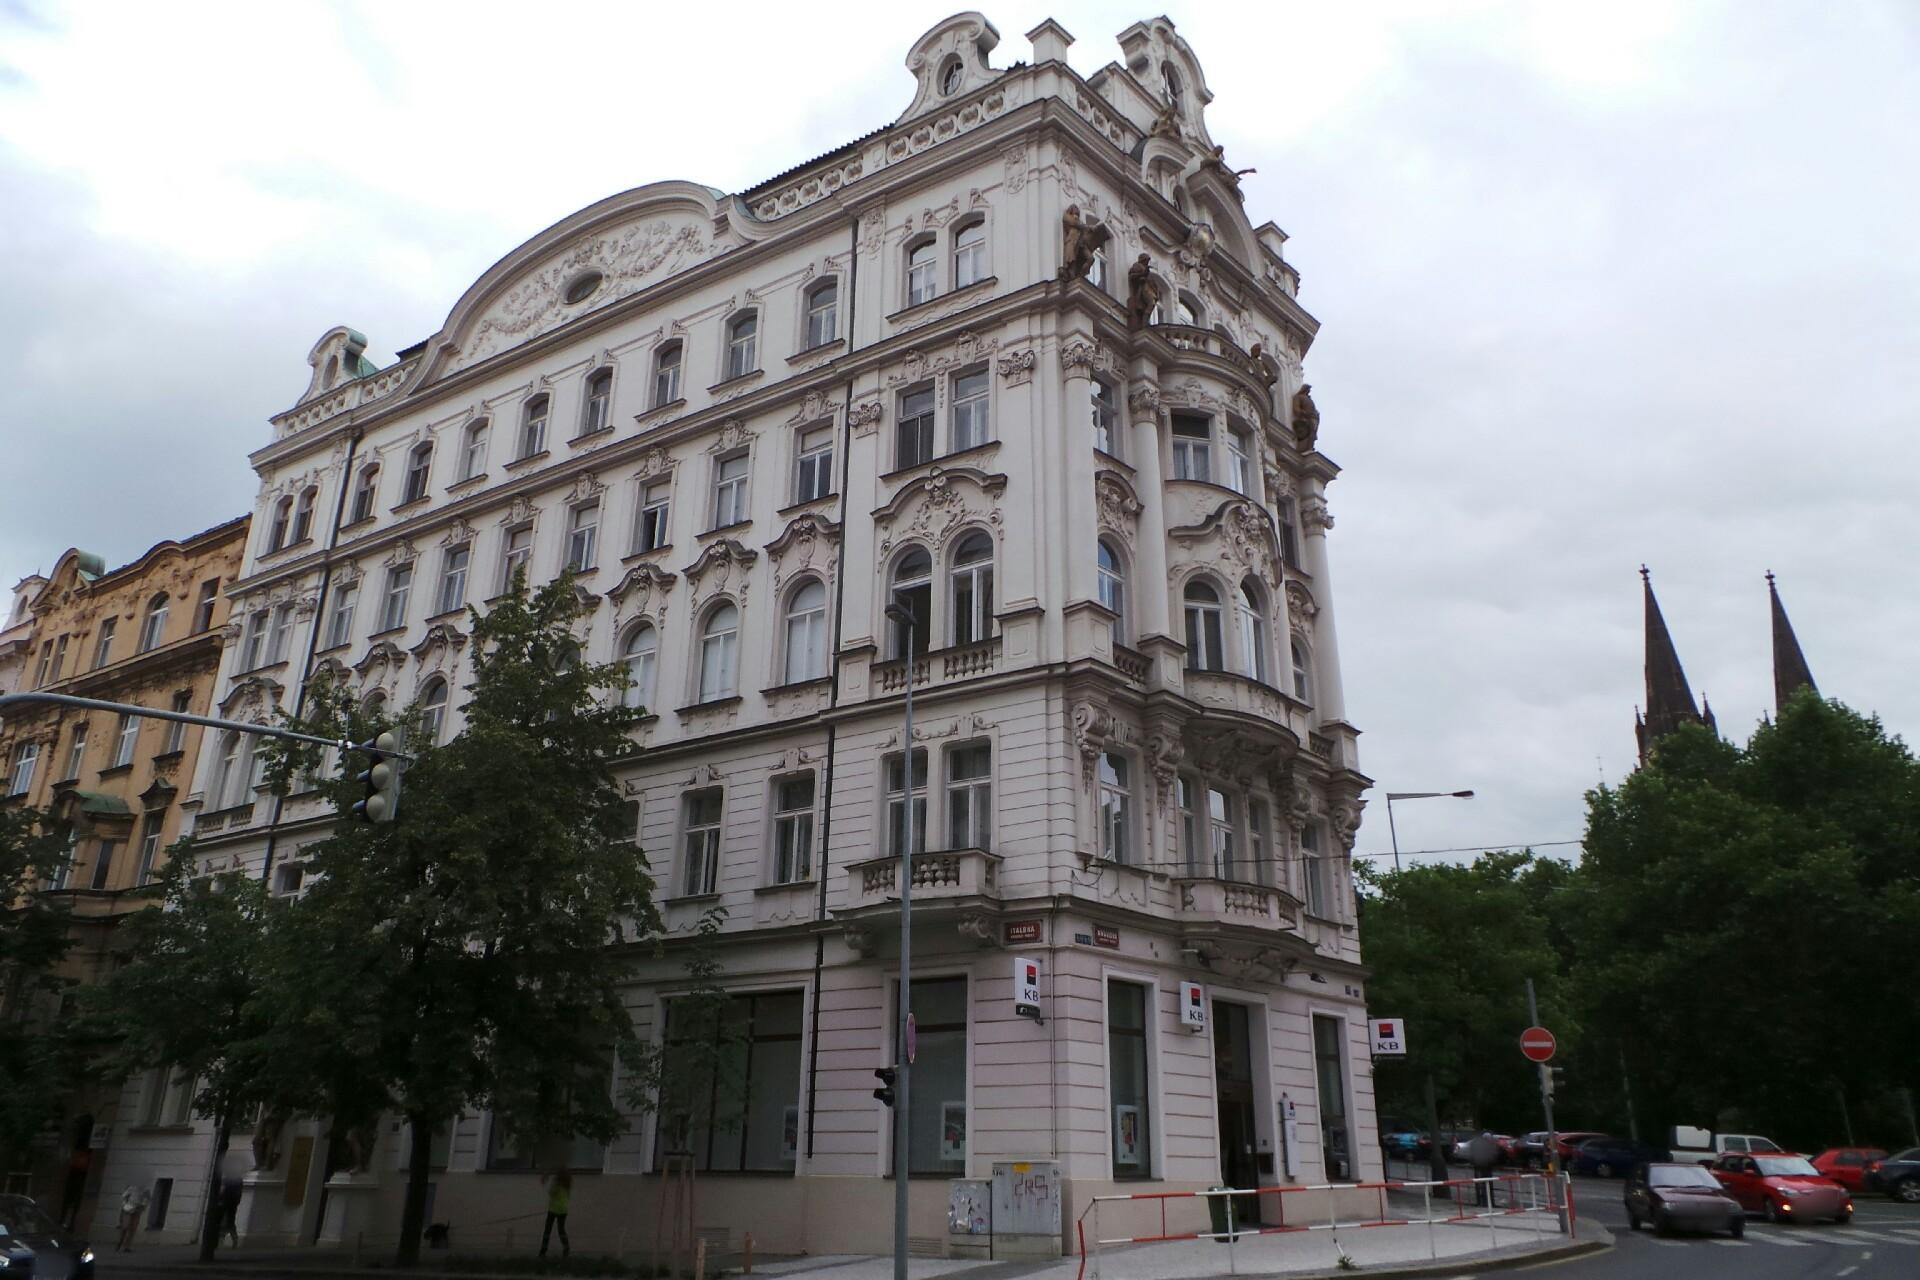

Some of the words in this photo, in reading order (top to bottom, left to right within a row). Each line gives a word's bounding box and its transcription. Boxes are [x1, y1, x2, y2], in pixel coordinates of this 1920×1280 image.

[1024, 988, 1039, 1001] KB
[1189, 1009, 1203, 1021] KB
[1377, 1041, 1399, 1051] KB
